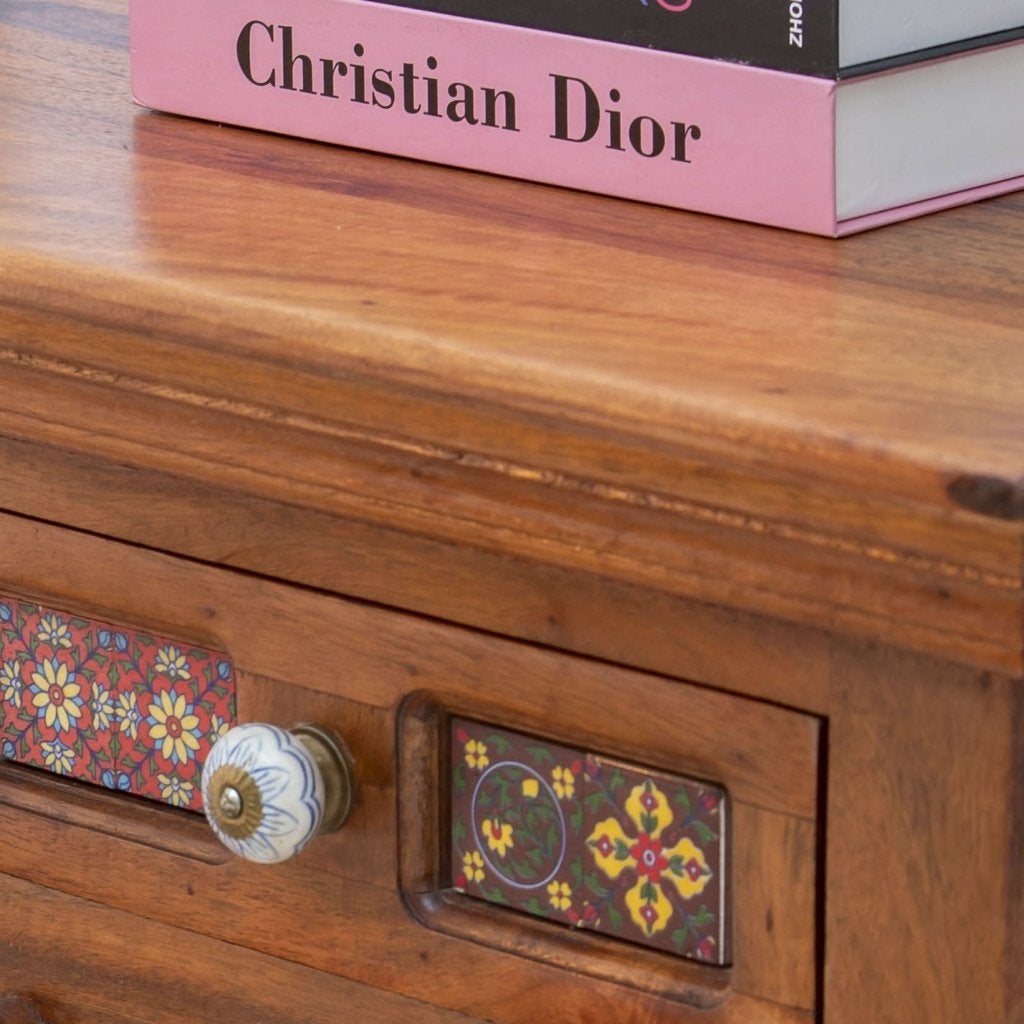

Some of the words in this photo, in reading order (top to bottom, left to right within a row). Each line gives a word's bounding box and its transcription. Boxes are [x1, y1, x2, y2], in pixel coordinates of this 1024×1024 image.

[789, 0, 803, 48] ZHO
[236, 20, 520, 132] Christian
[549, 73, 702, 164] Dior
